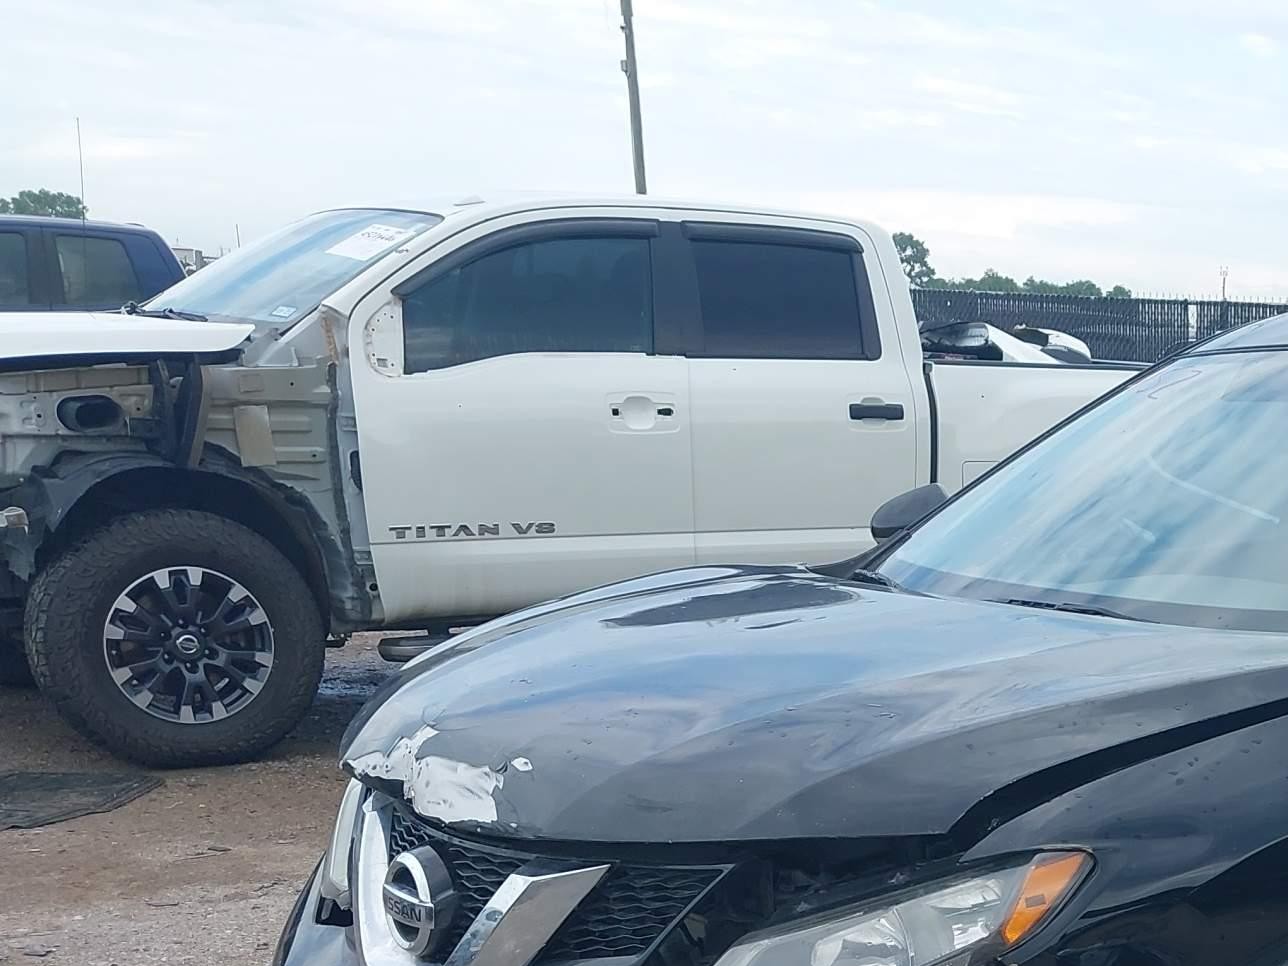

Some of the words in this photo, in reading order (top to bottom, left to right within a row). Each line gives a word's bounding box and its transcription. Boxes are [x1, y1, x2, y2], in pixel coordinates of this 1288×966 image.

[388, 522, 500, 540] TITAN
[511, 521, 556, 535] V8
[386, 896, 422, 922] SSAN
